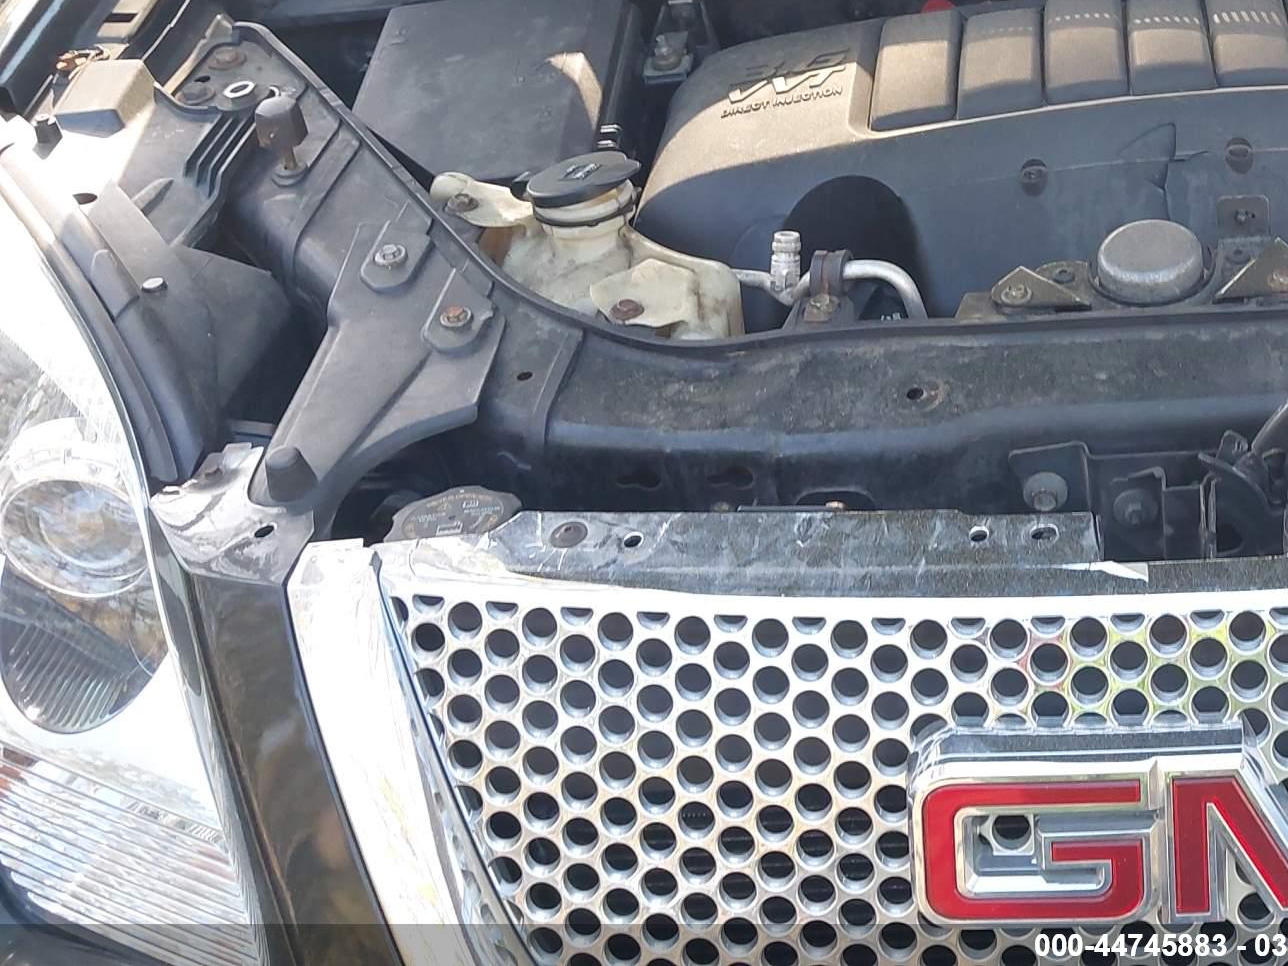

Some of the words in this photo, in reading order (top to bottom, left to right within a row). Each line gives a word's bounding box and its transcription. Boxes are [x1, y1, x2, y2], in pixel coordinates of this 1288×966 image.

[720, 99, 770, 119] DIRECT
[773, 85, 843, 108] INJECTION
[728, 65, 846, 103] VVT
